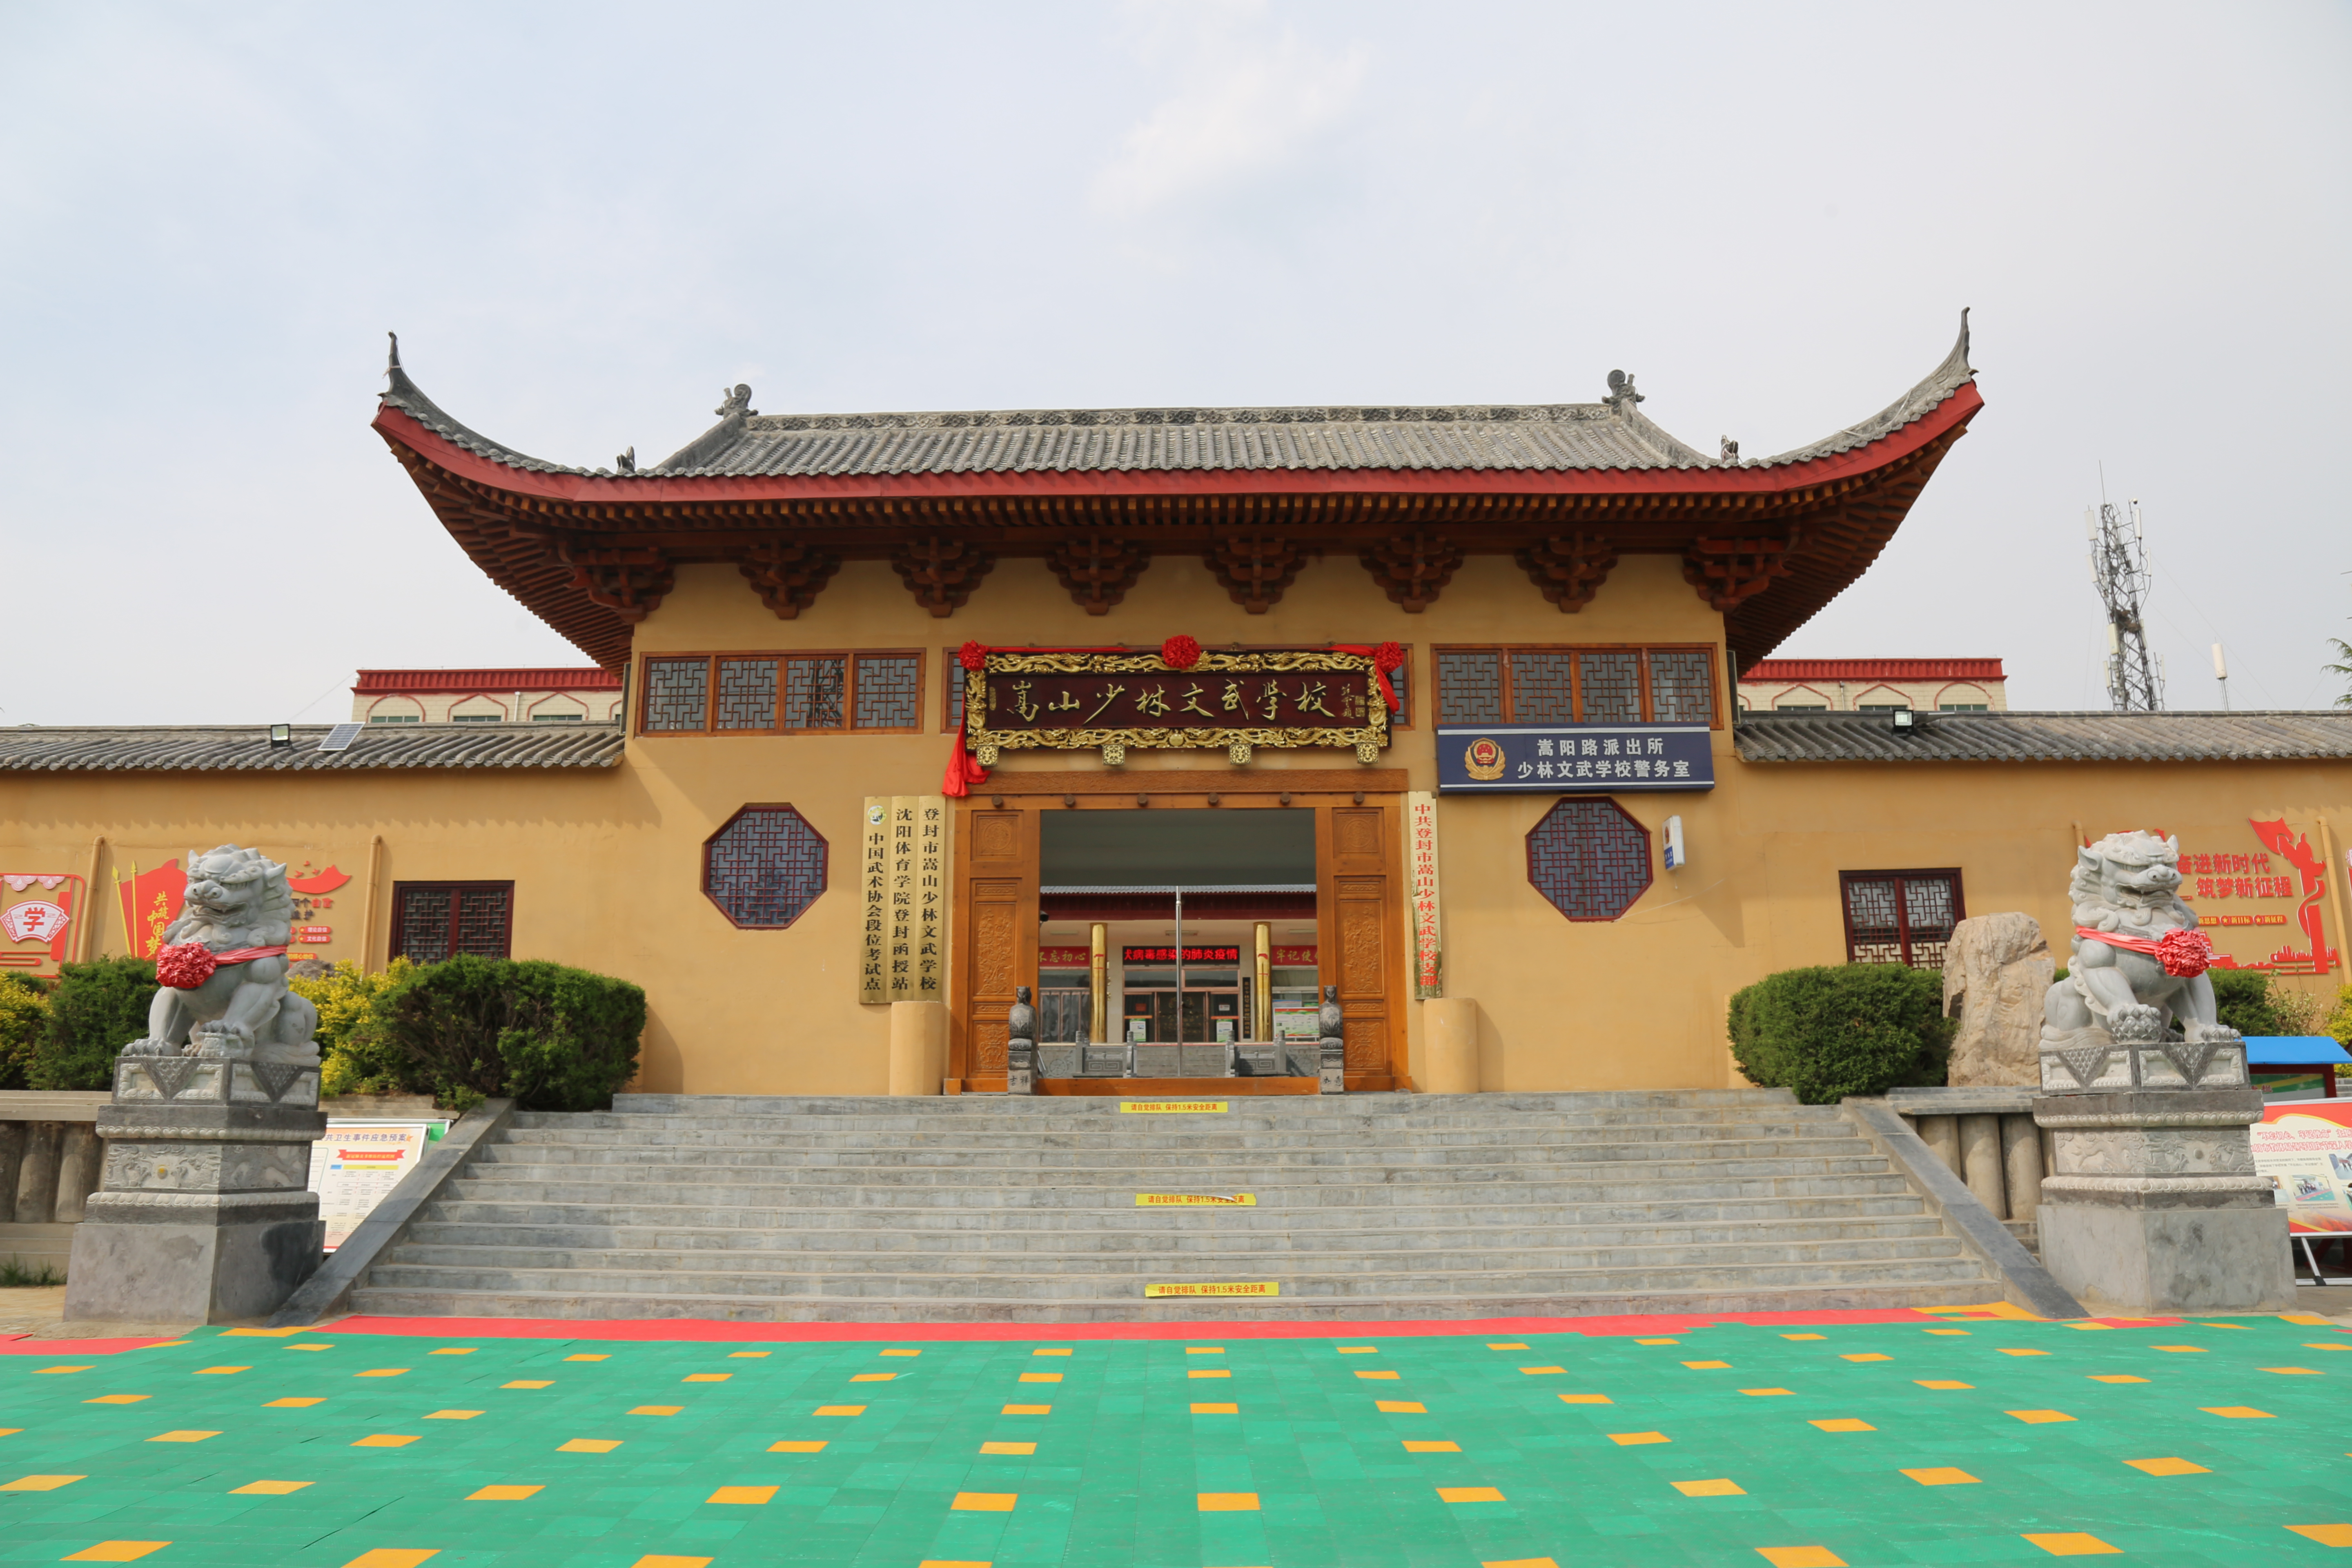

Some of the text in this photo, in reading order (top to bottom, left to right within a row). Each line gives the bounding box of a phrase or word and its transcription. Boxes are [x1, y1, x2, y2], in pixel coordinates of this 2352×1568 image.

[1537, 737, 1663, 757] 嵩阳路派出所
[1517, 760, 1690, 779] 少林文武学校警务室
[2177, 853, 2271, 874] 奋进新时代
[1414, 804, 1438, 986] 中共登封市嵩山少林文武学校支部
[2196, 876, 2294, 898] 筑梦新征程
[891, 808, 913, 990] 沈阳体育学院登封函授站
[919, 808, 940, 990] 登封市嵩山少林文武学校
[22, 906, 46, 932] 学
[864, 832, 884, 990] 中国武术协会段位考试点
[318, 1133, 407, 1142] 共卫生事件应急预案
[1158, 1285, 1266, 1294] 请自觉排队 保持1.5米安全距离
